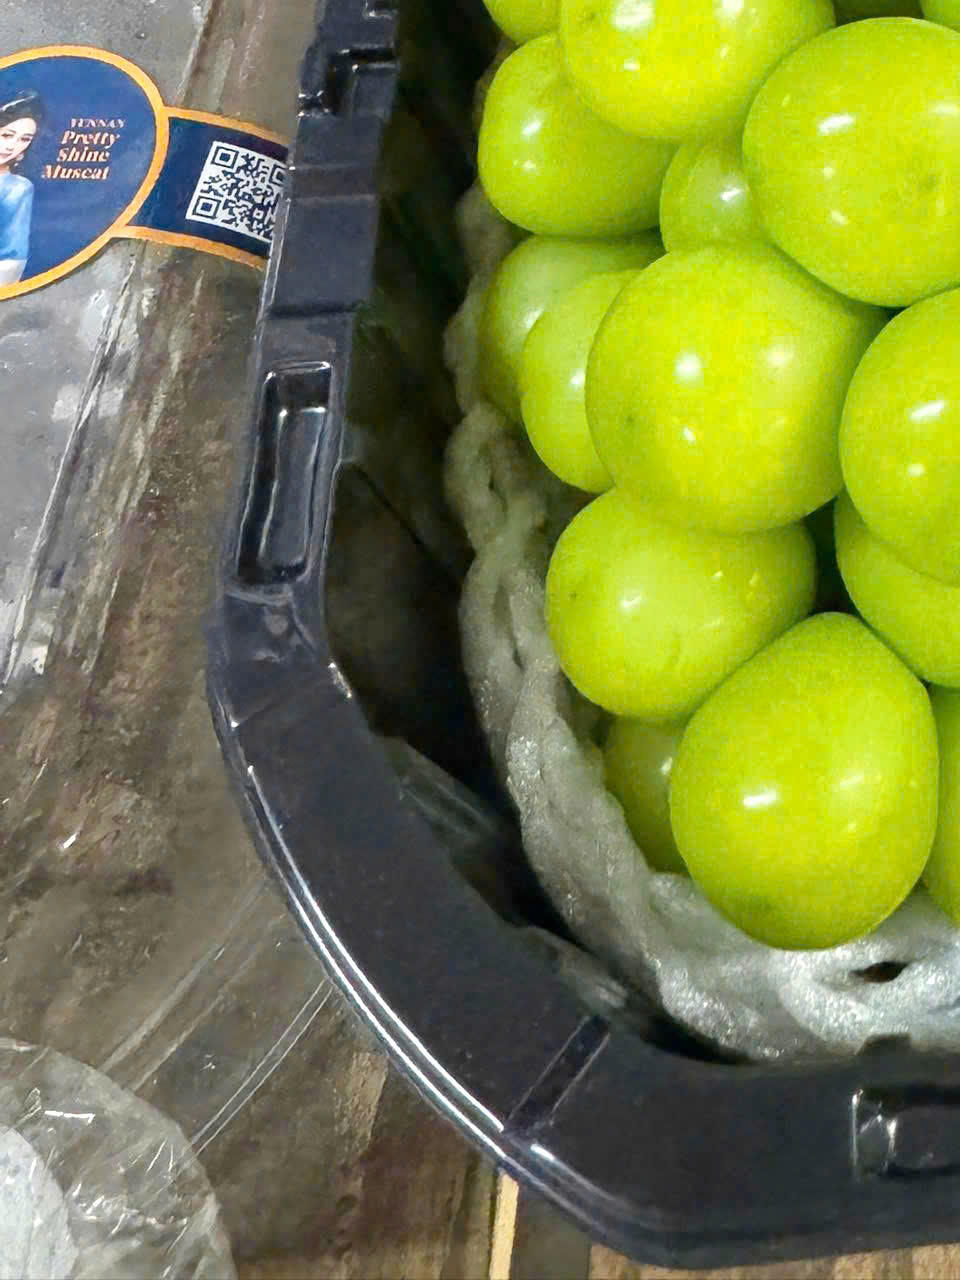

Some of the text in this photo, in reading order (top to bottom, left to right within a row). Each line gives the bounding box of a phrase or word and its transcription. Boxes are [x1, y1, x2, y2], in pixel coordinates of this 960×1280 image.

[61, 130, 120, 149] Pretty
[56, 146, 110, 162] Shine
[41, 164, 110, 180] Muscat
